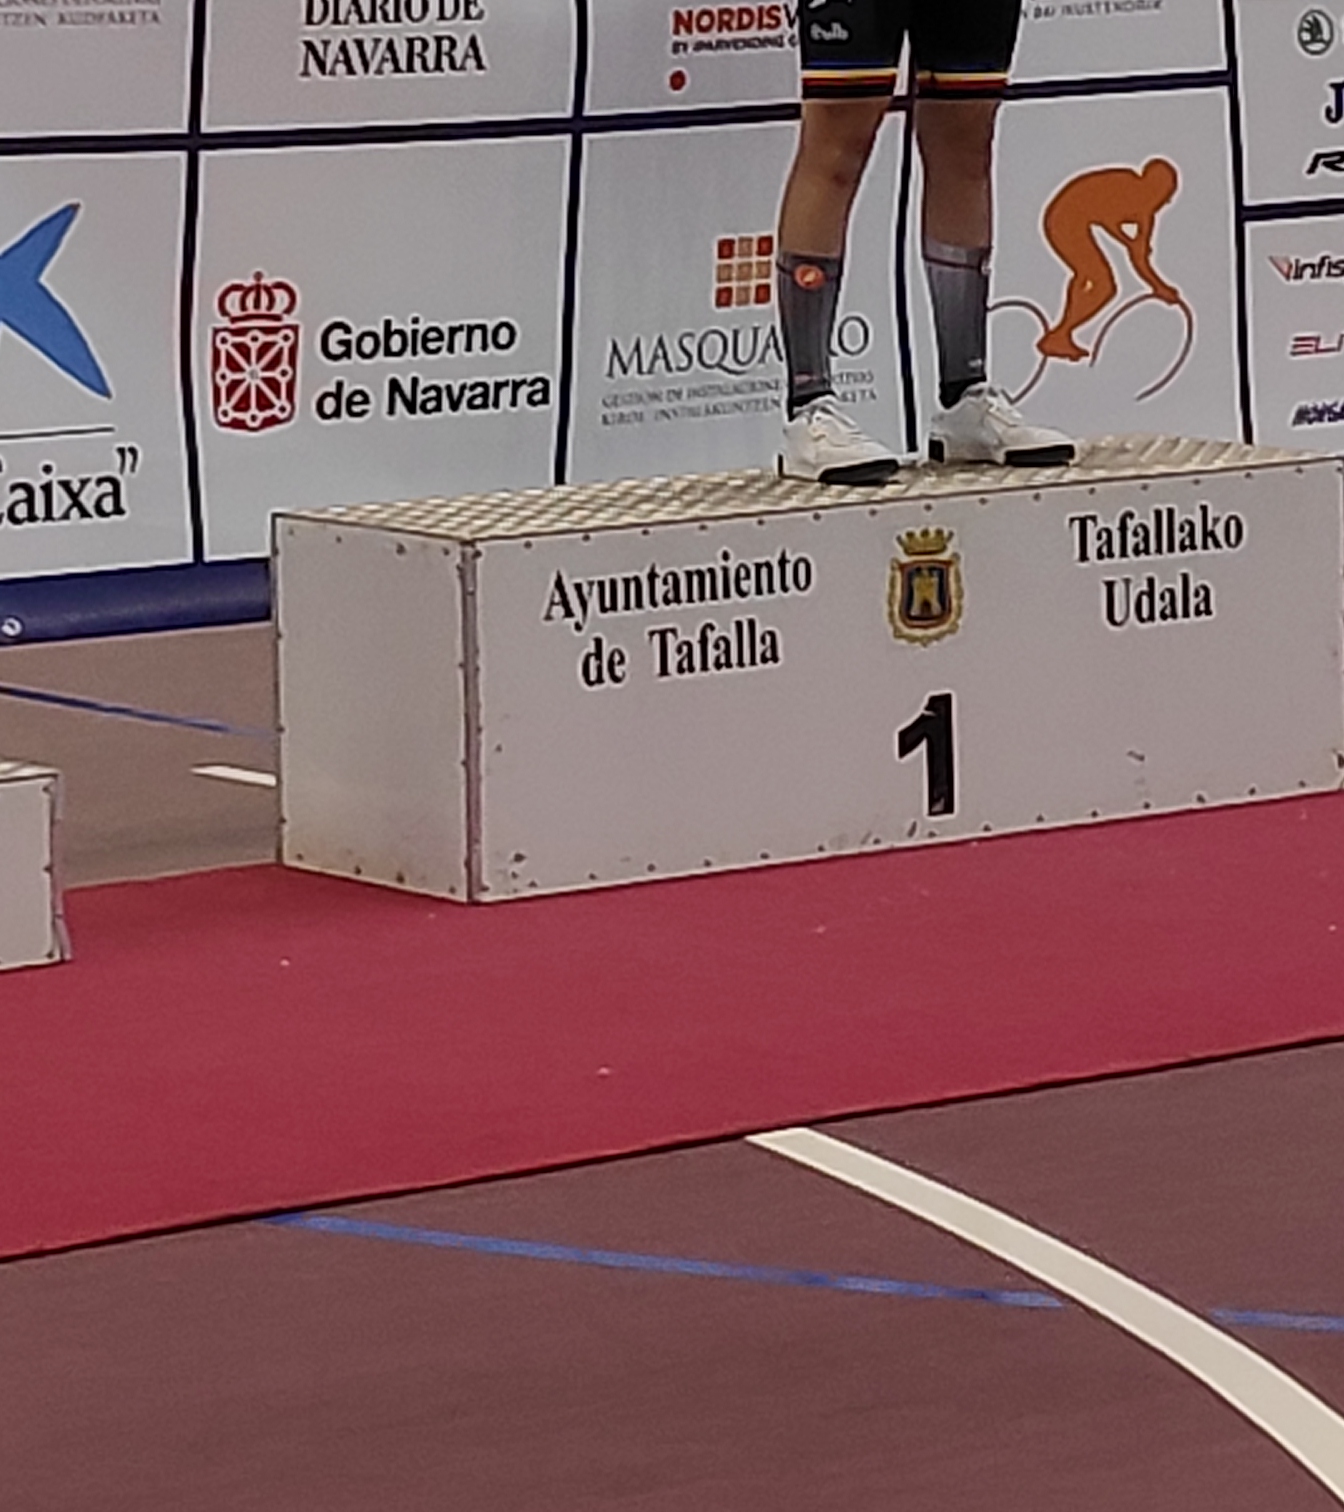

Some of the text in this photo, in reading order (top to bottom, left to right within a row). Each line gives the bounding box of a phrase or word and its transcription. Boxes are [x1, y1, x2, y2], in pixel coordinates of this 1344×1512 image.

[299, 33, 487, 80] NAVARRA
[319, 319, 517, 363] Gobierno
[315, 371, 552, 421] de Navarra
[1069, 506, 1244, 563] Tafallako
[544, 548, 813, 632] Ayuntamiento
[1104, 573, 1214, 628] Udala
[582, 618, 781, 688] de Tafalla
[898, 693, 955, 817] 1
